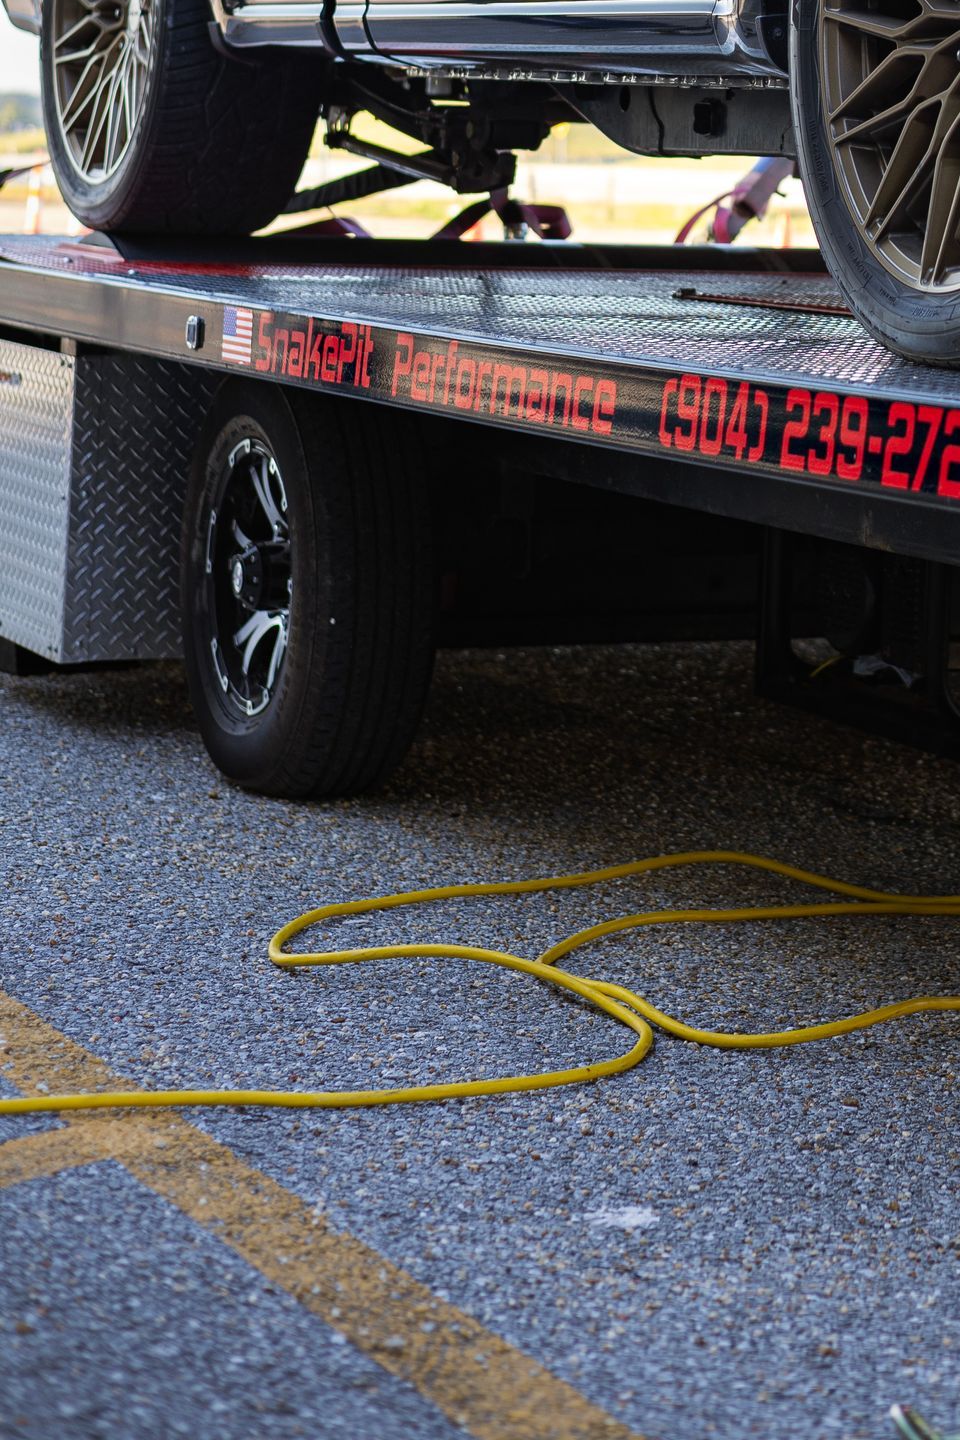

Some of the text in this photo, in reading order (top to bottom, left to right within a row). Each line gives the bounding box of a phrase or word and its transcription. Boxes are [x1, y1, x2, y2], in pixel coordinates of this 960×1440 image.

[254, 312, 375, 388] SnakePit
[391, 333, 617, 435] Performance
[658, 374, 769, 462] (904)
